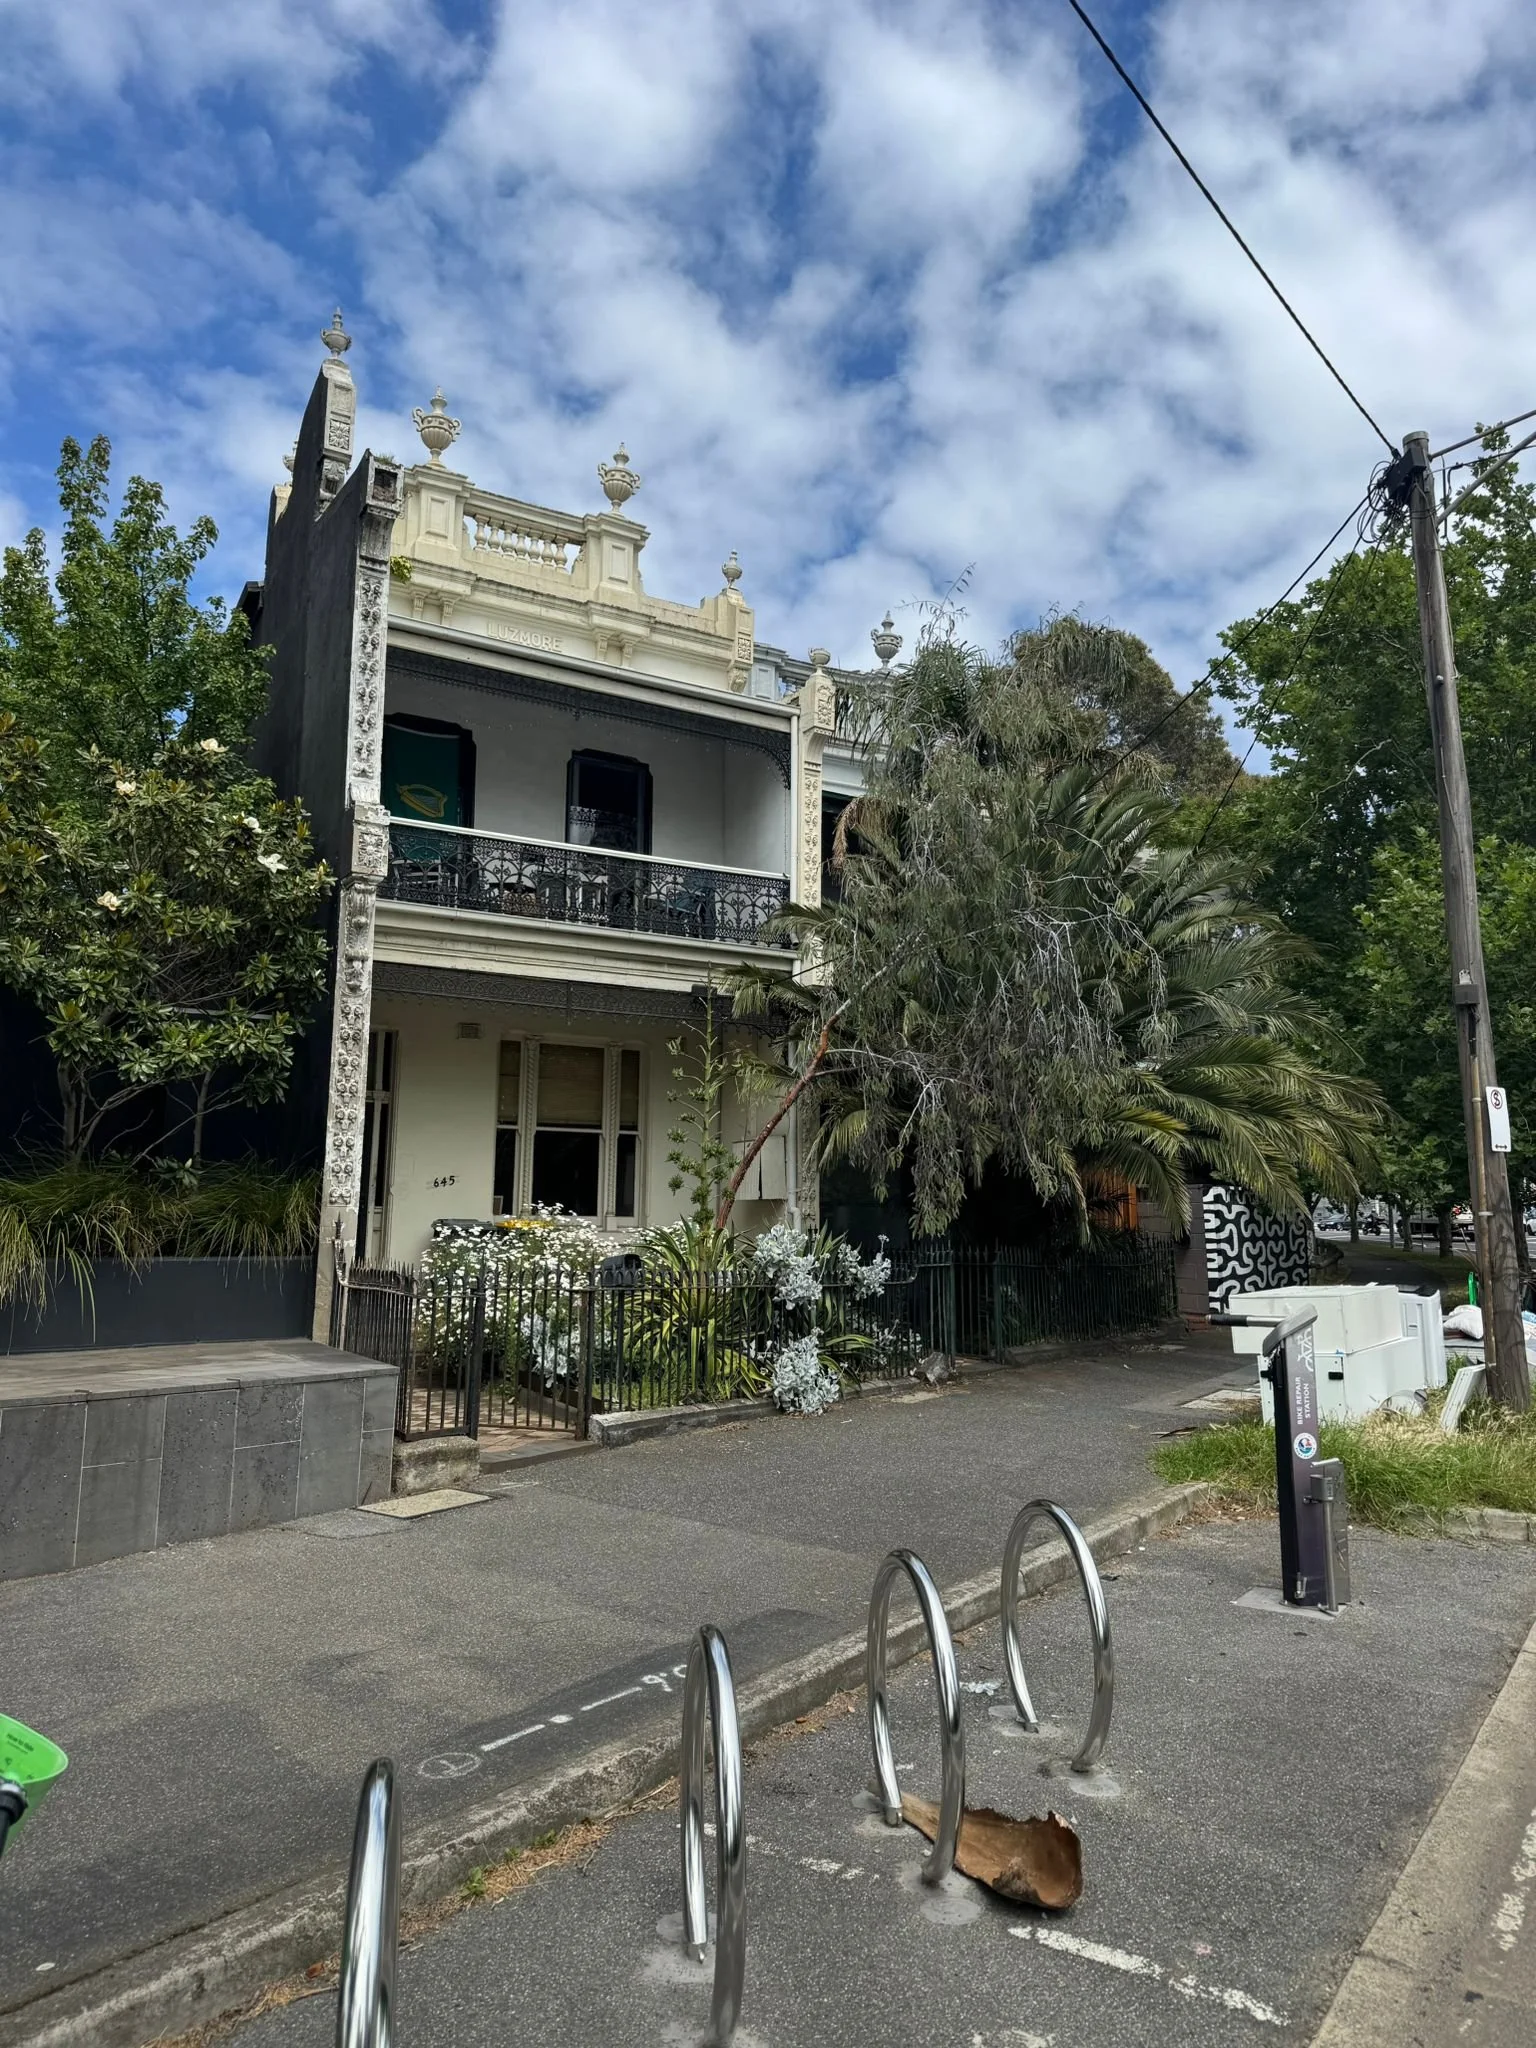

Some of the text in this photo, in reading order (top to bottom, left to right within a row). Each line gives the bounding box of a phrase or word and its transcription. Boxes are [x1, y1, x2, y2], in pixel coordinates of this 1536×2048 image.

[487, 621, 563, 652] LUZMORE
[433, 1175, 457, 1188] 645
[1295, 1376, 1304, 1425] BIKE REPAIR
[1303, 1383, 1311, 1419] STATION
